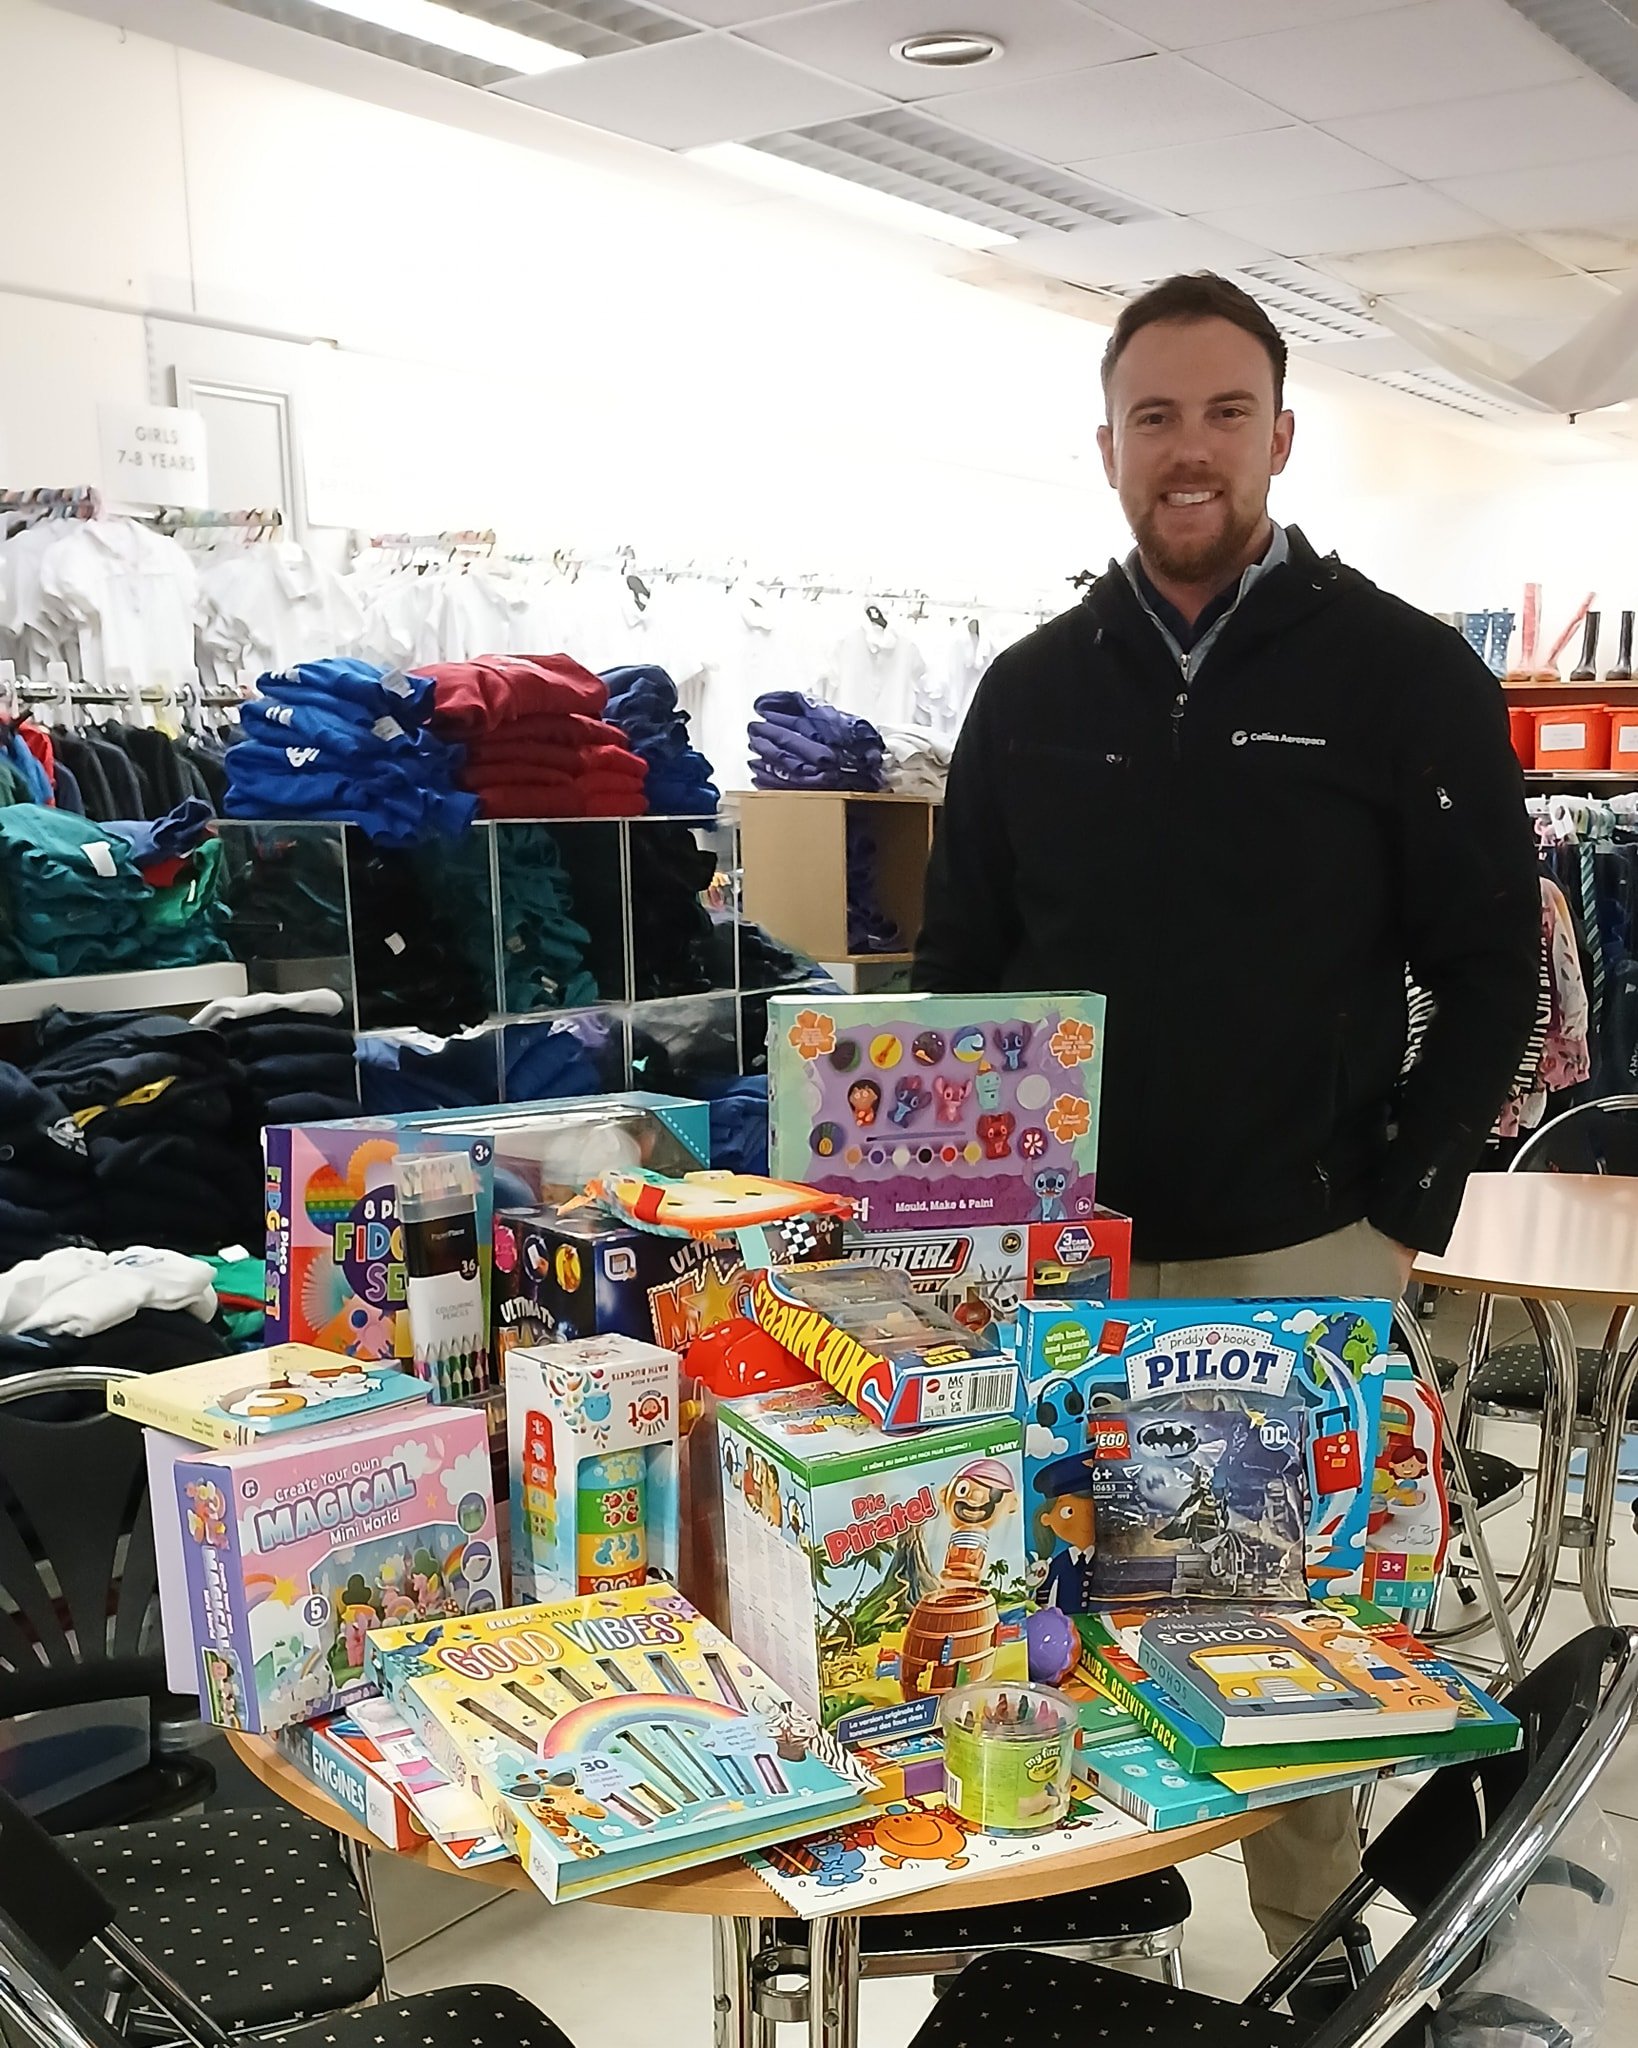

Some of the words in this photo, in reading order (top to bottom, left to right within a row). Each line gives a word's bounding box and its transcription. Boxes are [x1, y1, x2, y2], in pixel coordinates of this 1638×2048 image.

[135, 426, 178, 445] GIRLS
[118, 449, 142, 466] 7-8
[148, 453, 195, 471] YEARS
[1250, 732, 1280, 742] Collins
[1280, 734, 1327, 746] Aerospace
[474, 1144, 490, 1161] 3+
[364, 1200, 376, 1219] 8
[930, 1200, 956, 1210] Make
[958, 1199, 967, 1209] &
[968, 1198, 994, 1209] Paint
[266, 1166, 282, 1266] FIDGET
[1062, 1232, 1073, 1246] 3
[461, 1259, 476, 1273] 36
[365, 1262, 409, 1302] SE
[266, 1270, 281, 1321] SET
[435, 1301, 474, 1316] COLOURING
[500, 1296, 556, 1329] ULTIMATE
[1046, 1332, 1064, 1342] with
[1066, 1328, 1086, 1339] book
[1170, 1333, 1204, 1349] priddy
[1223, 1333, 1256, 1347] books
[1045, 1343, 1060, 1354] and
[1062, 1339, 1090, 1353] puzzle
[1055, 1352, 1082, 1366] pieces
[612, 1368, 646, 1381] BUCKETS
[648, 1364, 669, 1375] BATH
[1145, 1348, 1279, 1390] PILOT
[1262, 1426, 1289, 1444] DC
[988, 1440, 1019, 1454] TOMY
[275, 1478, 318, 1502] Create
[320, 1467, 349, 1486] Your
[351, 1457, 381, 1474] Own
[1092, 1467, 1113, 1481] 6+
[256, 1465, 416, 1552] MAGICAL
[852, 1494, 886, 1518] Pic
[329, 1523, 360, 1545] Mini
[362, 1508, 400, 1532] World
[824, 1486, 936, 1565] Pirate!
[1381, 1560, 1402, 1573] 3+
[309, 1601, 321, 1619] 5
[538, 1608, 581, 1621] MANIA
[1157, 1627, 1288, 1645] SCHOOL
[438, 1630, 563, 1680] GOOD
[552, 1613, 683, 1653] VIBES
[1145, 1650, 1187, 1701] SCHOOL
[1081, 1649, 1108, 1685] SAURS
[1111, 1678, 1151, 1726] ACTIVITY
[1151, 1717, 1178, 1754] PACK
[849, 1726, 878, 1738] tonneau
[879, 1722, 892, 1730] des
[908, 1713, 923, 1722] rires
[859, 1715, 884, 1727] version
[885, 1707, 914, 1720] originale
[1025, 1754, 1042, 1768] my
[1042, 1747, 1060, 1758] first
[1099, 1745, 1154, 1759] Puzzle
[580, 1760, 608, 1772] 30
[312, 1745, 365, 1813] ENGINES
